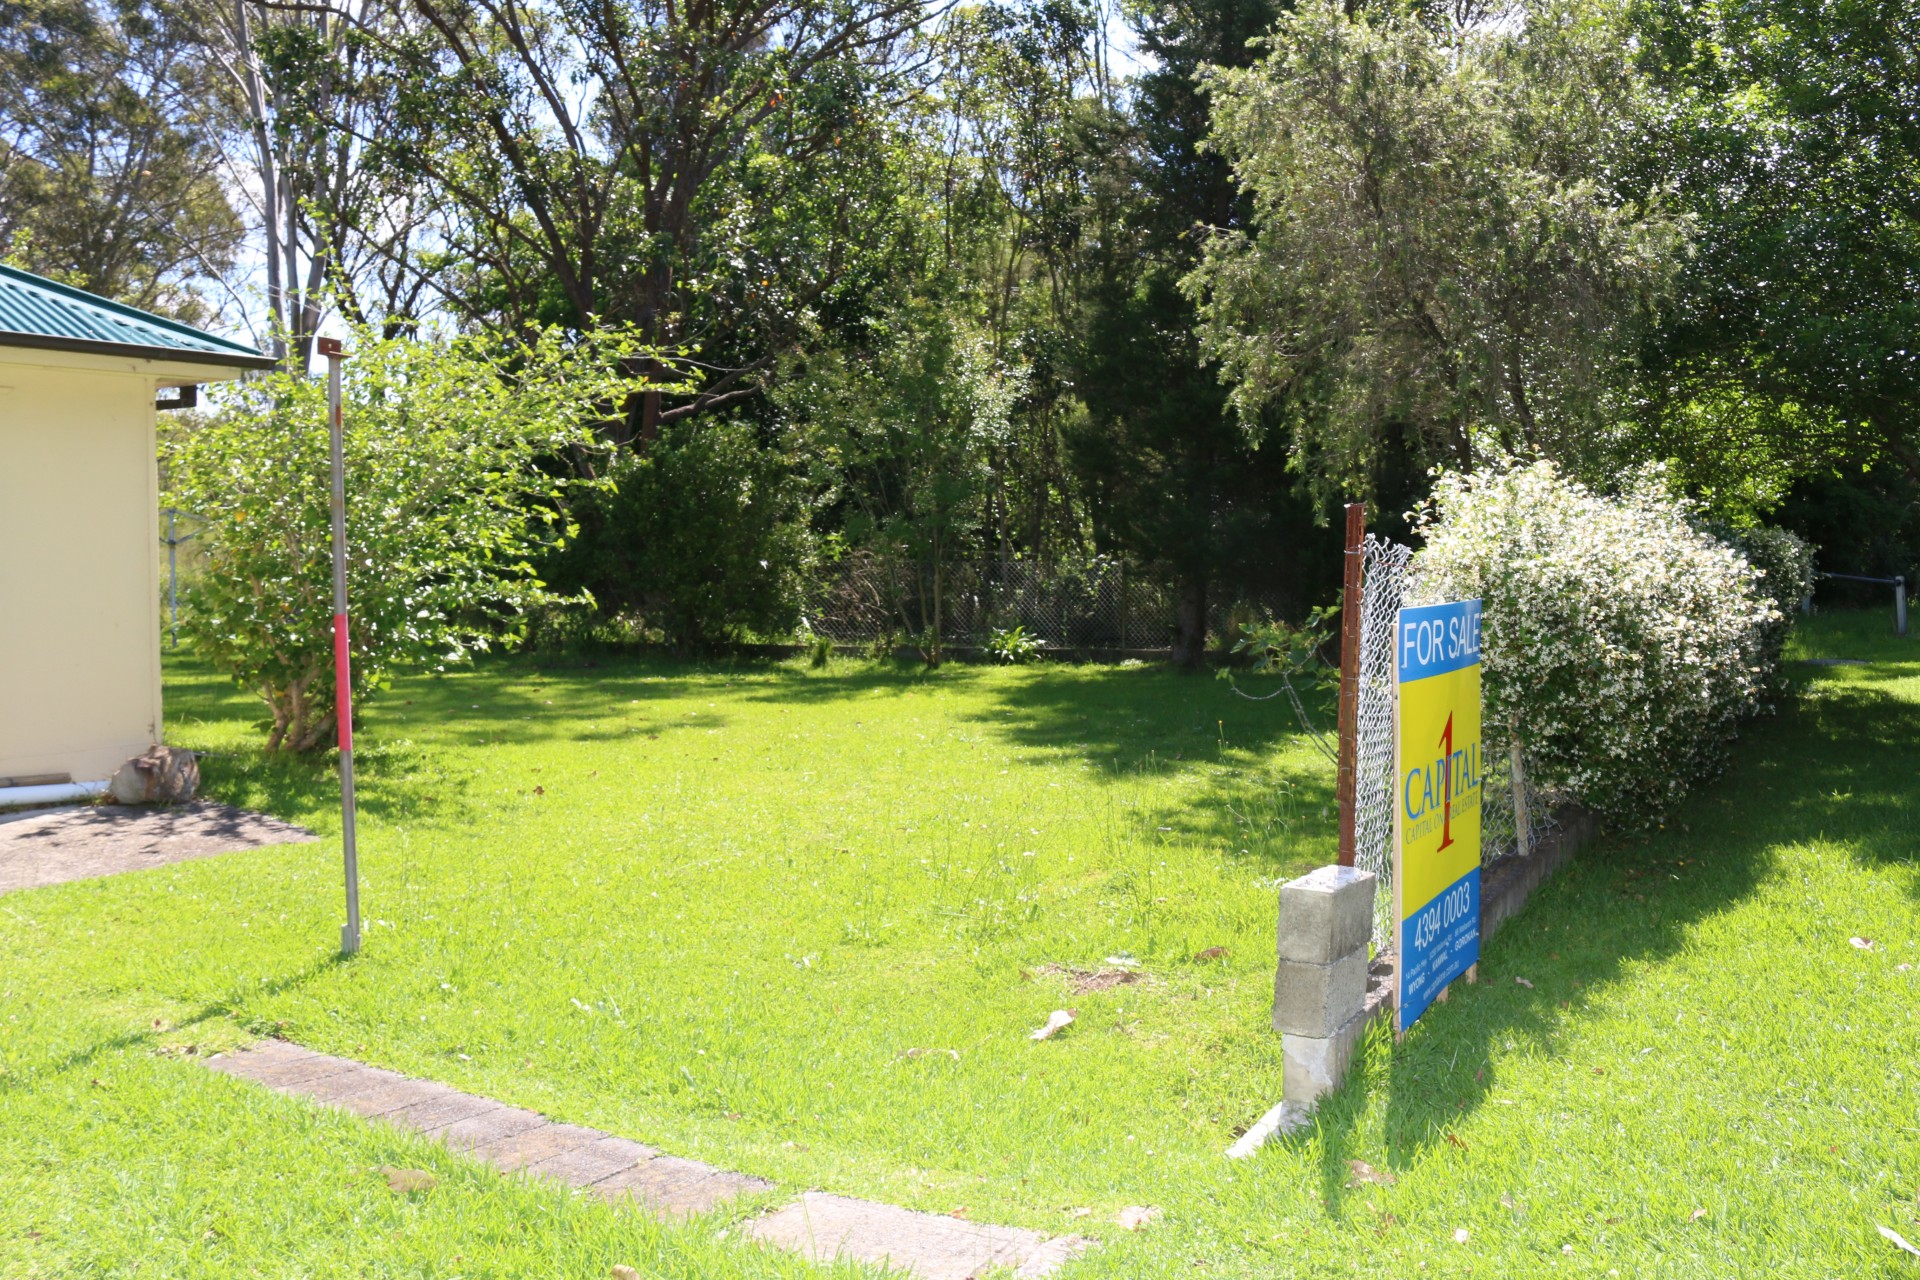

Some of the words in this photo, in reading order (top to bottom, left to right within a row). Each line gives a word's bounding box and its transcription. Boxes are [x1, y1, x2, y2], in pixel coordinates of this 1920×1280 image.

[1403, 619, 1444, 668] FOR
[1449, 613, 1480, 659] SALE
[1405, 743, 1479, 820] CAPITAL
[1406, 818, 1432, 845] CAPITAL
[1462, 791, 1478, 813] ESTATE
[1414, 901, 1441, 951] 4394
[1443, 881, 1470, 928] 0003
